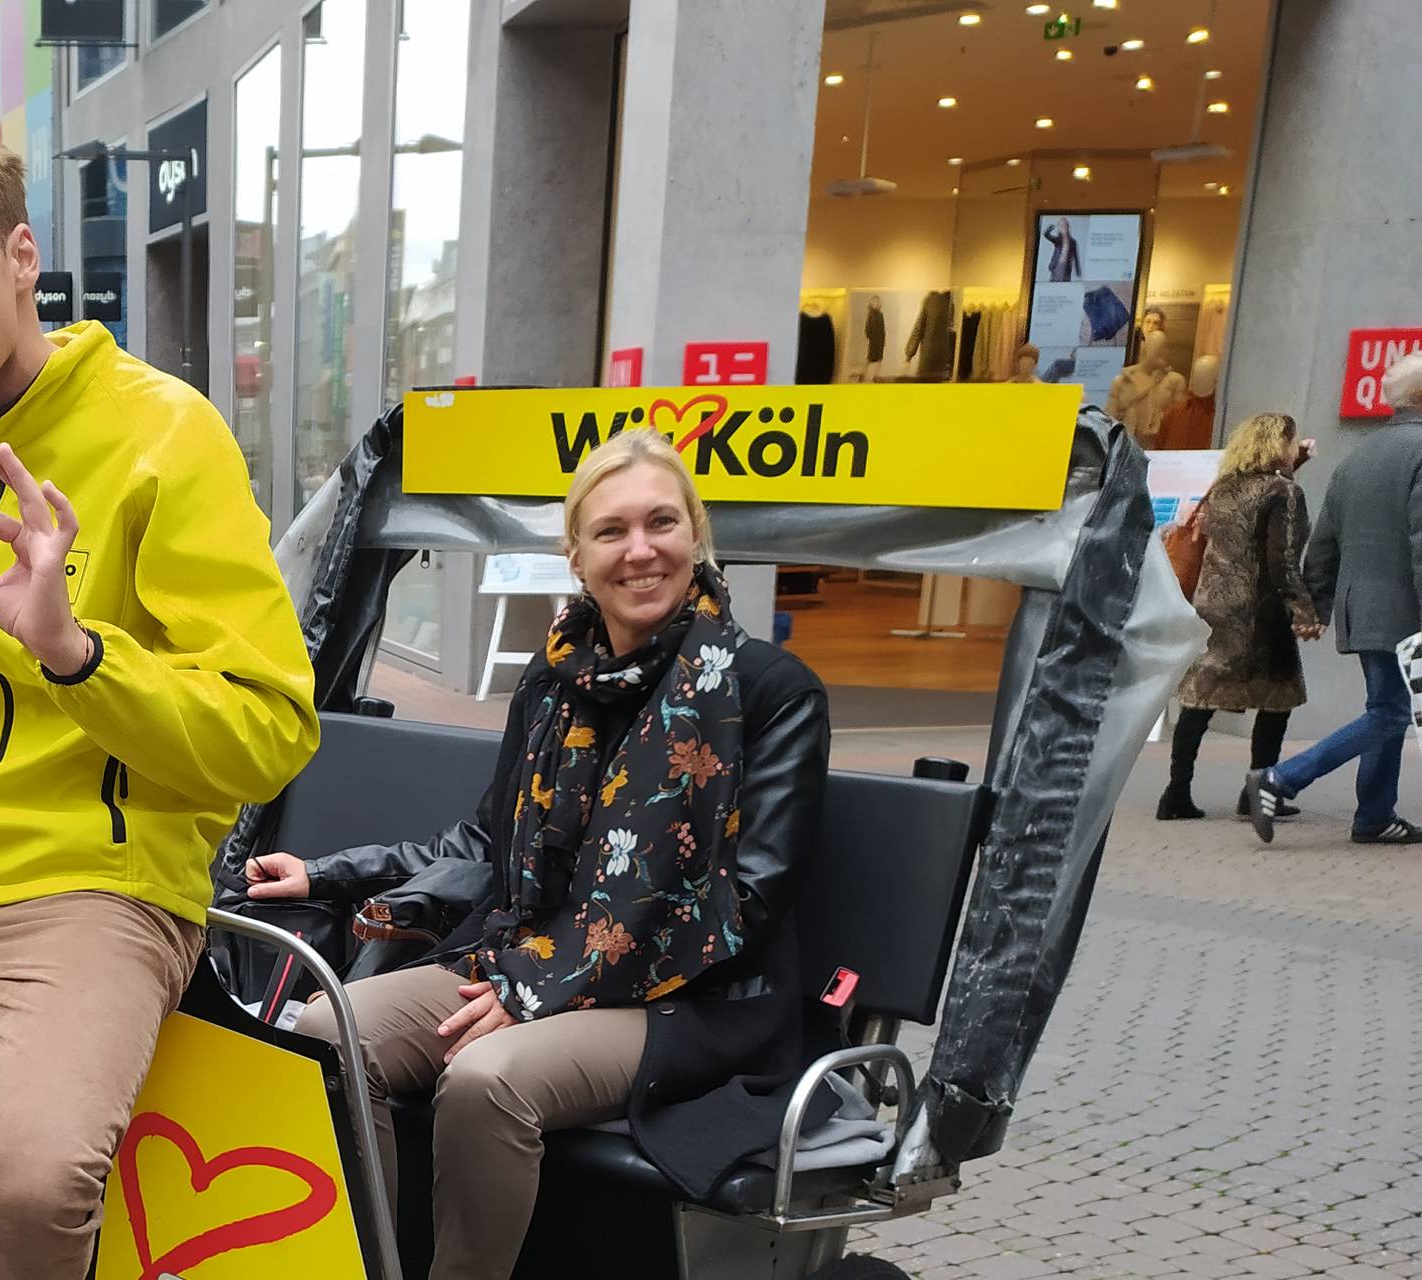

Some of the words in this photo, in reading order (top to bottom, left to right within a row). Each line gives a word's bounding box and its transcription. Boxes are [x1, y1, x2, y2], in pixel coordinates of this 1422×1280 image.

[159, 148, 198, 204] dys
[35, 289, 67, 305] dyson
[550, 406, 675, 474] Wi
[694, 403, 869, 478] Köln
